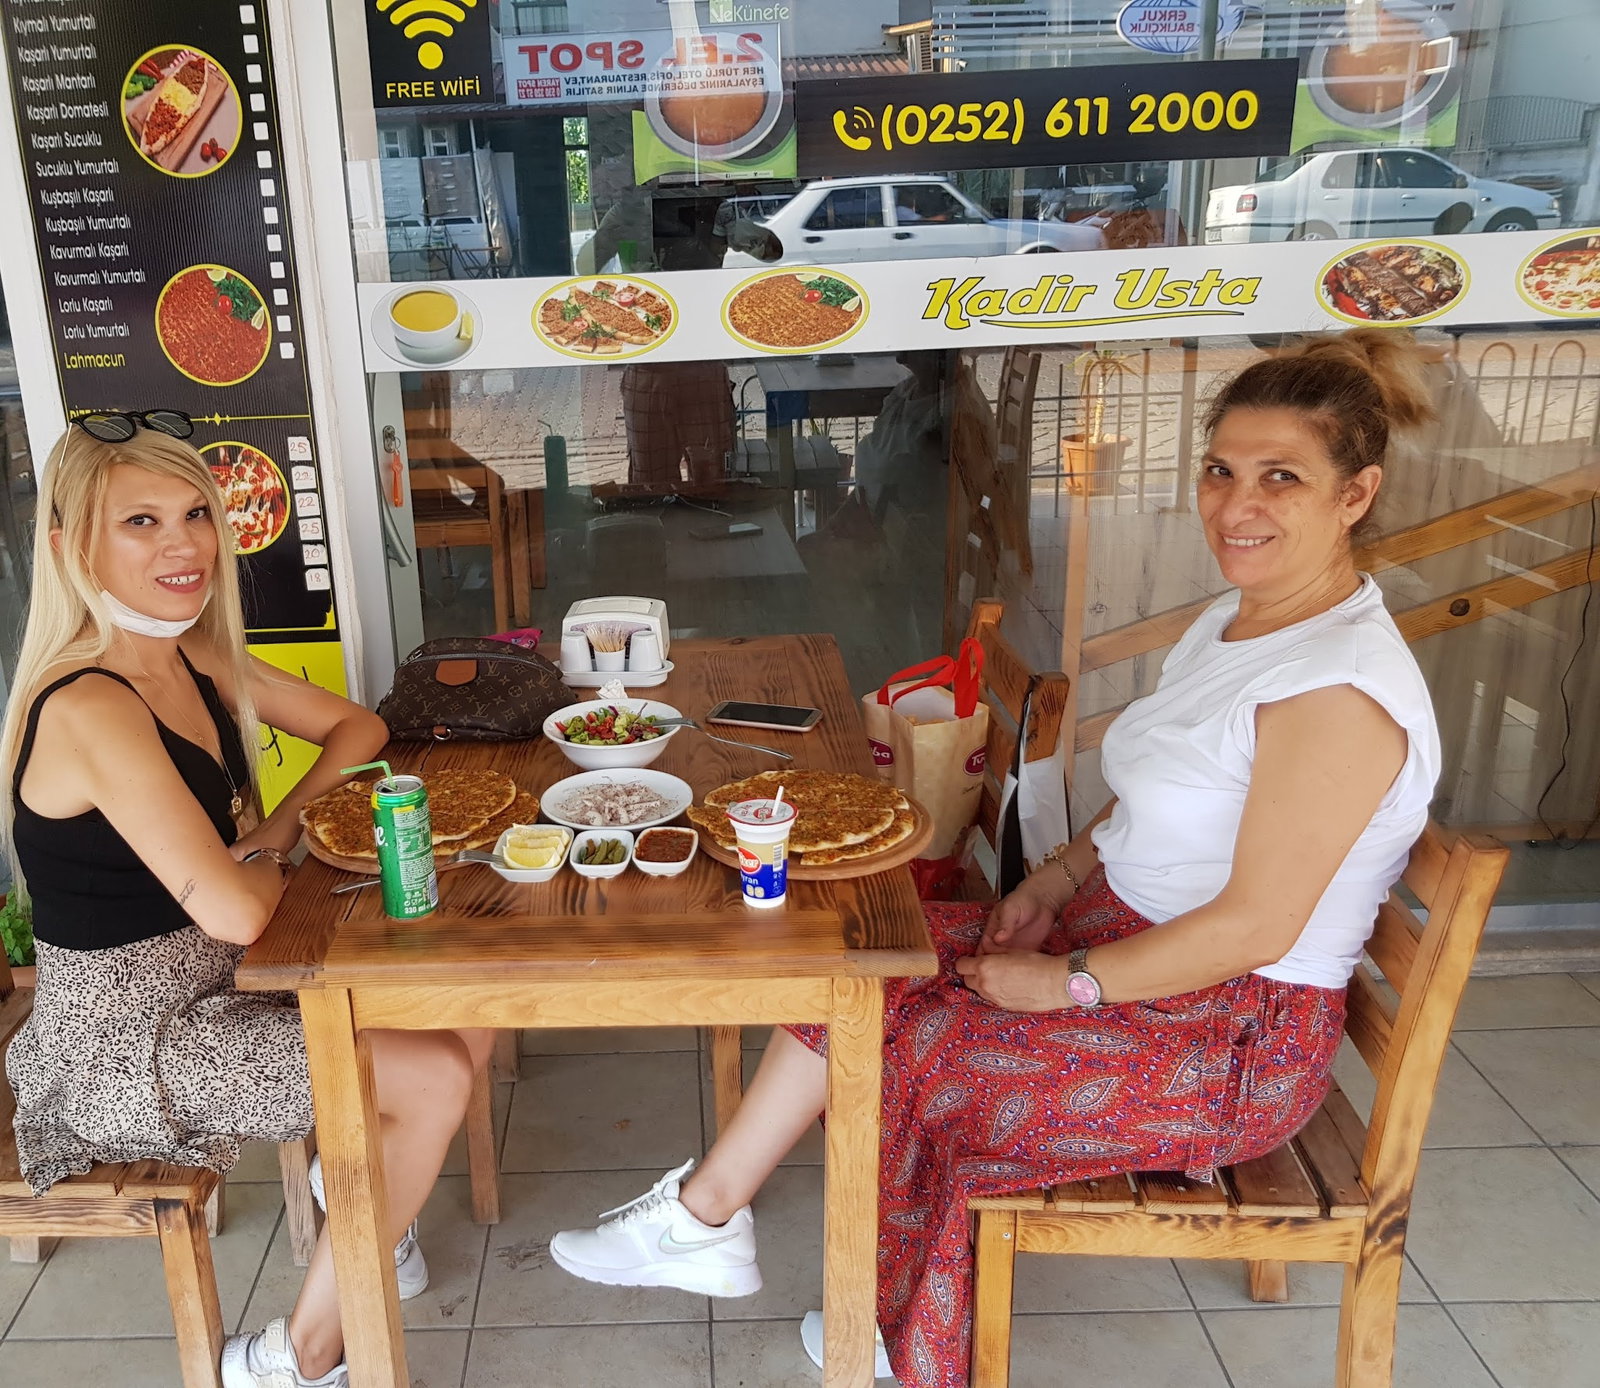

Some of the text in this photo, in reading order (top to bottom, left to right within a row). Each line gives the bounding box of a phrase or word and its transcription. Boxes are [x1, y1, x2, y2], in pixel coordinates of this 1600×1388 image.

[49, 13, 97, 31] Yumurtalı
[18, 42, 97, 66] Kaşarlı Yumurtalı
[23, 72, 95, 95] Kaşarlı Mantarlı
[386, 82, 437, 99] FREE
[27, 101, 109, 124] Kaşarlı Domatesli
[880, 89, 1259, 150] (0252) 611 2000
[31, 131, 102, 152] Kaşarlı Sucuklu
[36, 160, 119, 177] Sucuklu Yumurtalı
[41, 187, 114, 206] Kuşbaşılı Kaşarlı
[45, 215, 131, 234] Kuşbaşılı Yumurtalı
[50, 242, 129, 260] Kavurmalı Kaşarlı
[54, 269, 146, 287] Kavurmalı Yumurtalı
[59, 297, 113, 313] Lorlu Kaşarlı
[921, 267, 1261, 330] Kadir Usta
[63, 323, 130, 340] Lorlu Yumurtalı
[65, 352, 126, 369] Lahmacun
[290, 441, 307, 453] 25
[298, 496, 315, 508] 22
[301, 522, 320, 535] 25
[310, 573, 321, 583] 18
[405, 906, 417, 914] 330
